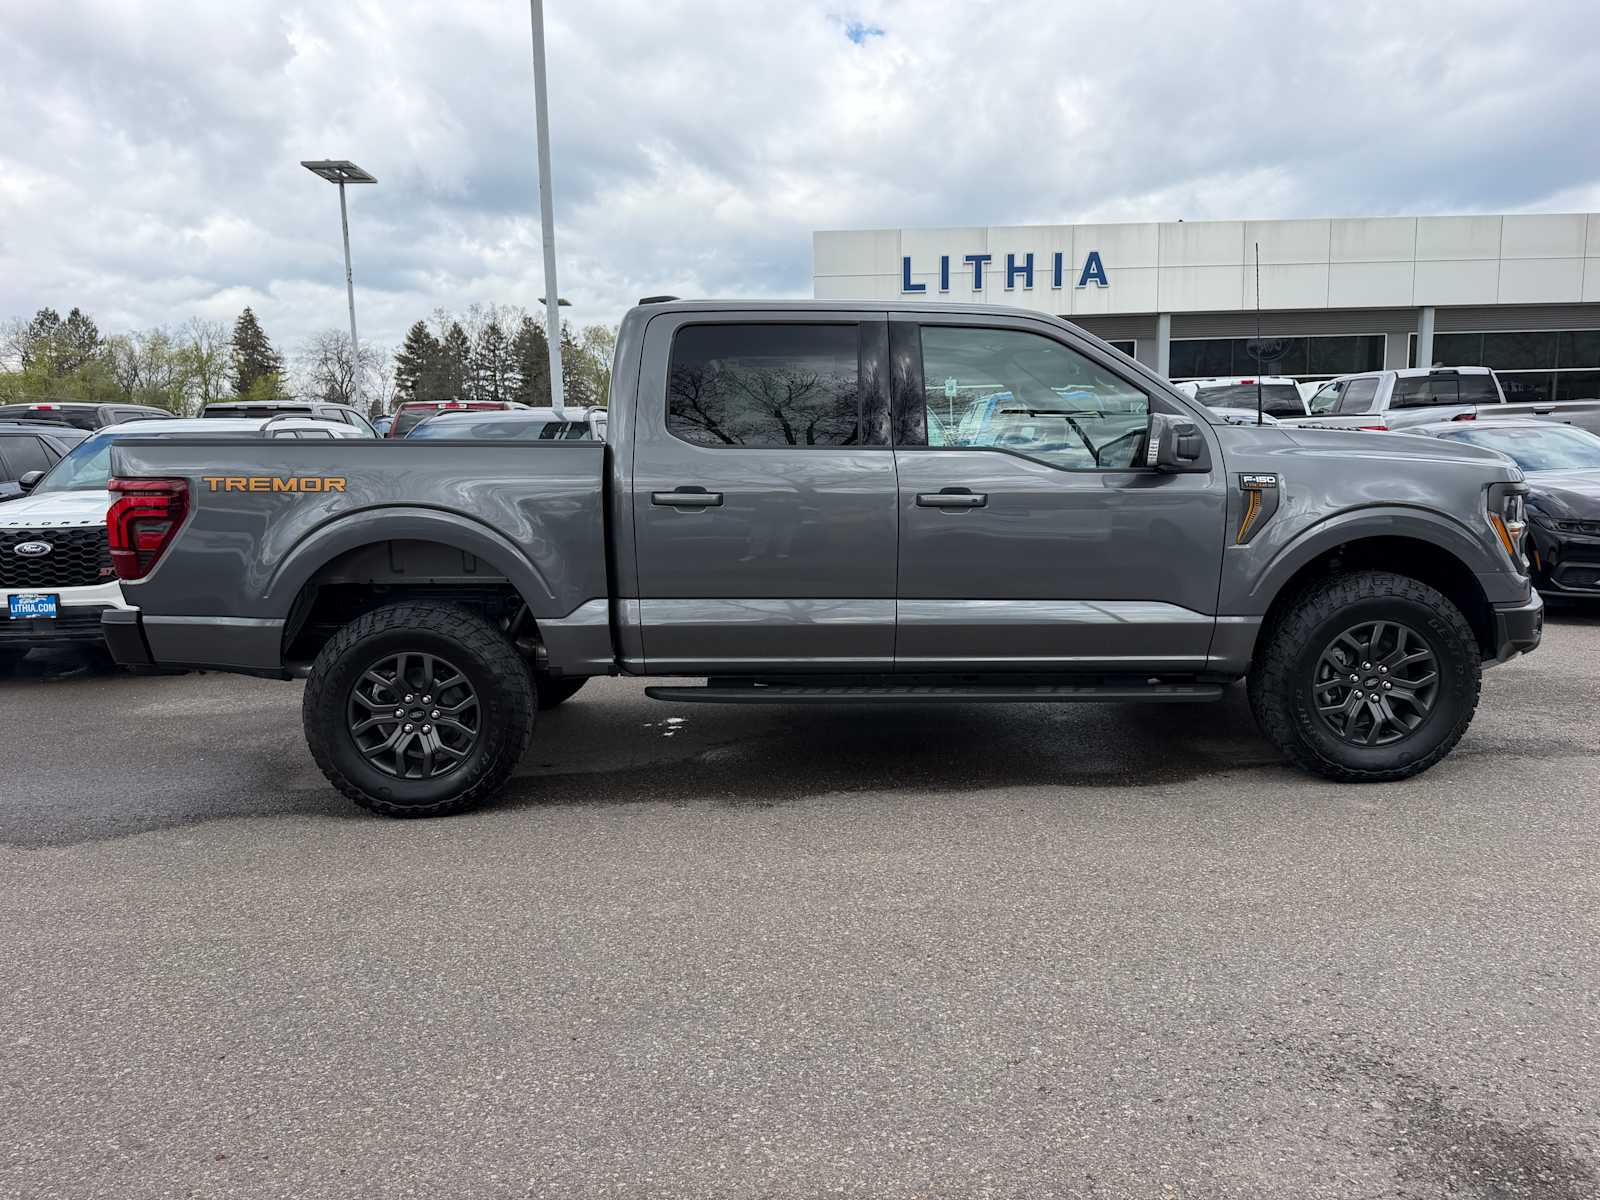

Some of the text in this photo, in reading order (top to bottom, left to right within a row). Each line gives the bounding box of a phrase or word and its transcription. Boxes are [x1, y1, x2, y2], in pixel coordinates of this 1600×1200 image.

[902, 251, 1109, 292] LITHIA
[203, 476, 346, 492] TREMOR
[10, 603, 56, 613] LITHIA.COM
